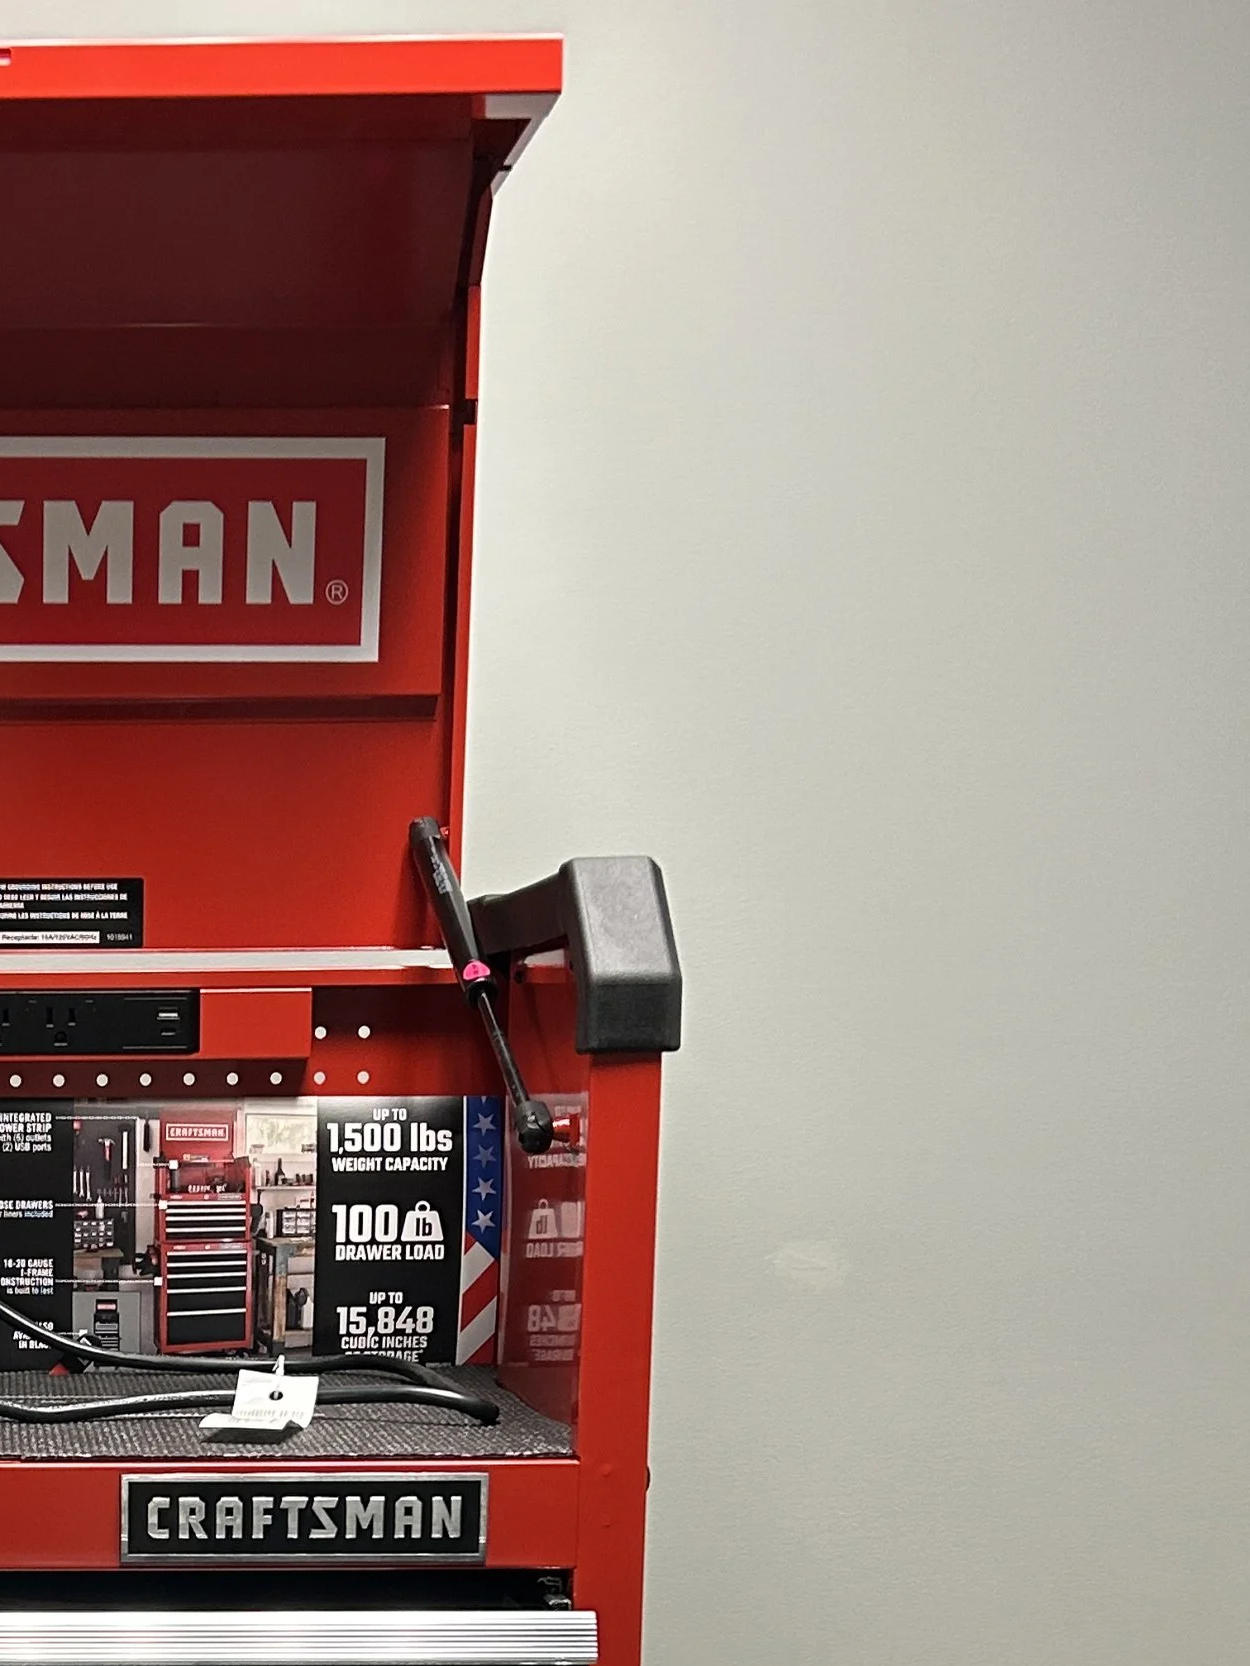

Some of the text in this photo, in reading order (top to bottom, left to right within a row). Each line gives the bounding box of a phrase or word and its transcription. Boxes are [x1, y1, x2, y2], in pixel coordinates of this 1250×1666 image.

[0, 1113, 52, 1122] INTEGRATED
[373, 1109, 407, 1121] UP TO
[26, 1123, 52, 1133] STRIP
[170, 1127, 226, 1137] CRAFTSMAN
[26, 1133, 52, 1142] outlets
[327, 1122, 453, 1154] 1,500 lbs
[2, 1143, 13, 1152] (2)
[15, 1143, 31, 1152] USB
[33, 1143, 52, 1152] ports
[332, 1156, 448, 1172] WEIGHT CAPACITY
[15, 1200, 54, 1210] DRAWERS
[332, 1204, 432, 1243] 100 lb
[335, 1244, 444, 1260] DRAWER LOAD
[28, 1259, 53, 1268] GAUGE
[41, 1287, 54, 1295] last
[369, 1292, 403, 1304] UP TO
[336, 1307, 434, 1337] 15,848
[19, 1341, 27, 1349] IN
[341, 1336, 428, 1349] CUBIC INCHES
[147, 1496, 462, 1539] CRAFTSMAN
